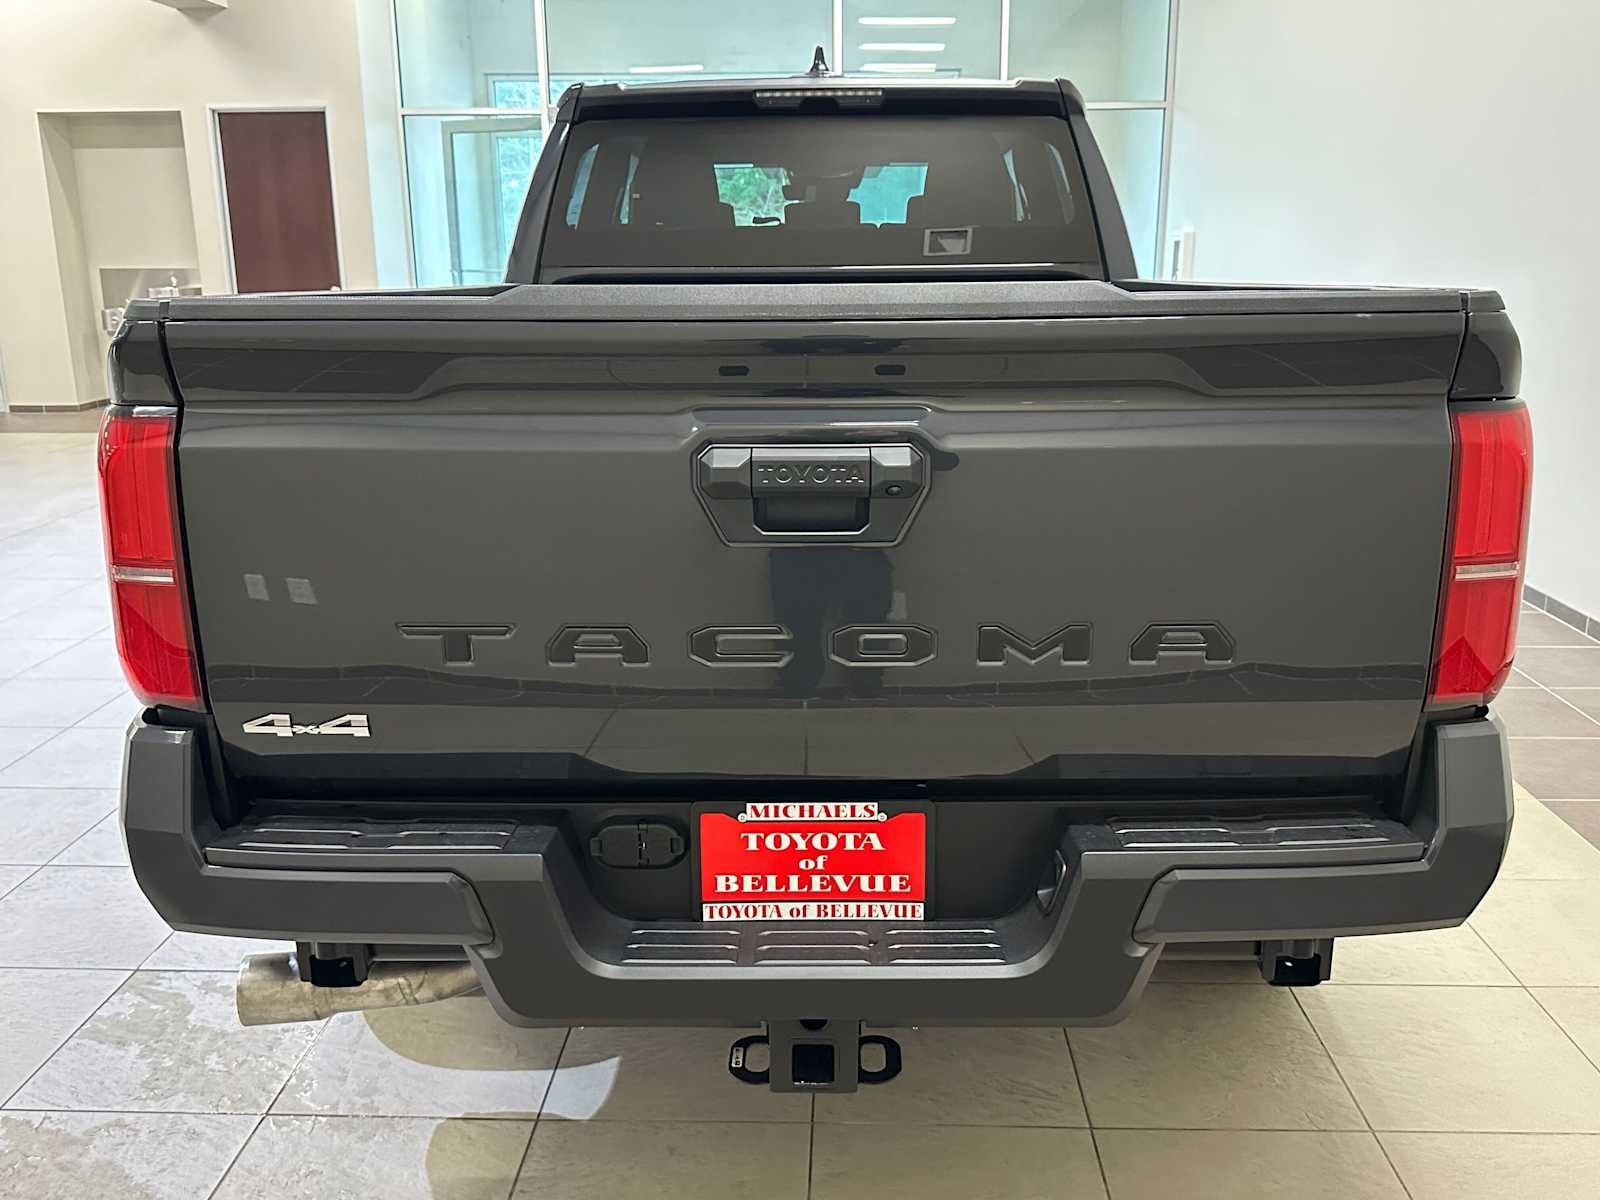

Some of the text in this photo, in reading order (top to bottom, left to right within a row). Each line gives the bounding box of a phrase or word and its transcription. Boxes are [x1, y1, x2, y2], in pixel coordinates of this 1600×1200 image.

[757, 464, 865, 484] TOYOTA
[395, 621, 1236, 669] TACOMA
[750, 804, 876, 819] MICHAELS
[740, 832, 886, 851] TOYOTA
[798, 854, 829, 871] of
[714, 874, 912, 893] BELLEVUE
[704, 904, 922, 919] TOYOTA of BELLEVUE
